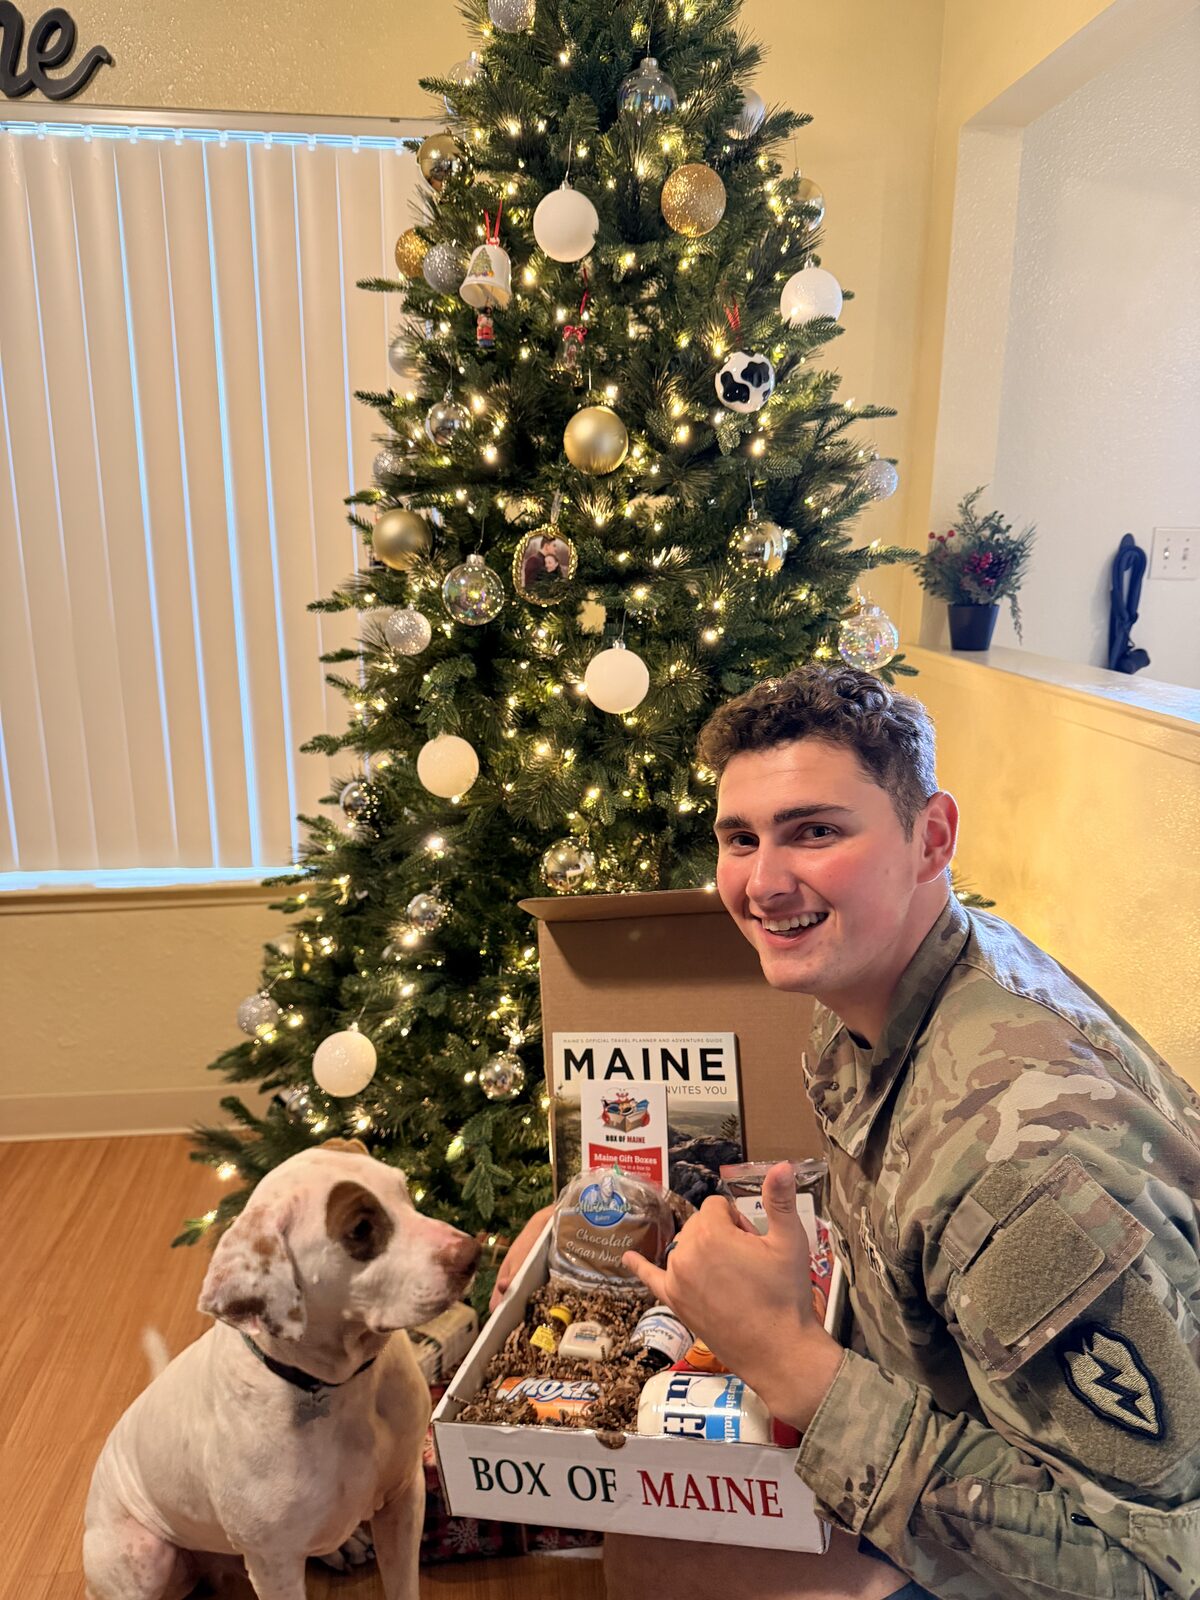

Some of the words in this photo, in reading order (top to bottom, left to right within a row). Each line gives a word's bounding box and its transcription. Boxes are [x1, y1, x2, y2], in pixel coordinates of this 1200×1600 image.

[564, 1048, 726, 1081] MAINE
[666, 1085, 701, 1095] NVITES
[704, 1085, 728, 1096] YOU
[605, 1135, 618, 1143] BOX
[618, 1135, 626, 1143] OF
[627, 1135, 645, 1144] MAINE
[594, 1153, 618, 1163] Maine
[619, 1153, 634, 1163] Gift
[634, 1155, 657, 1165] Boxes
[576, 1229, 633, 1248] Chocolate
[468, 1457, 551, 1498] BOX
[567, 1465, 617, 1503] OF
[636, 1470, 784, 1519] MAINE
